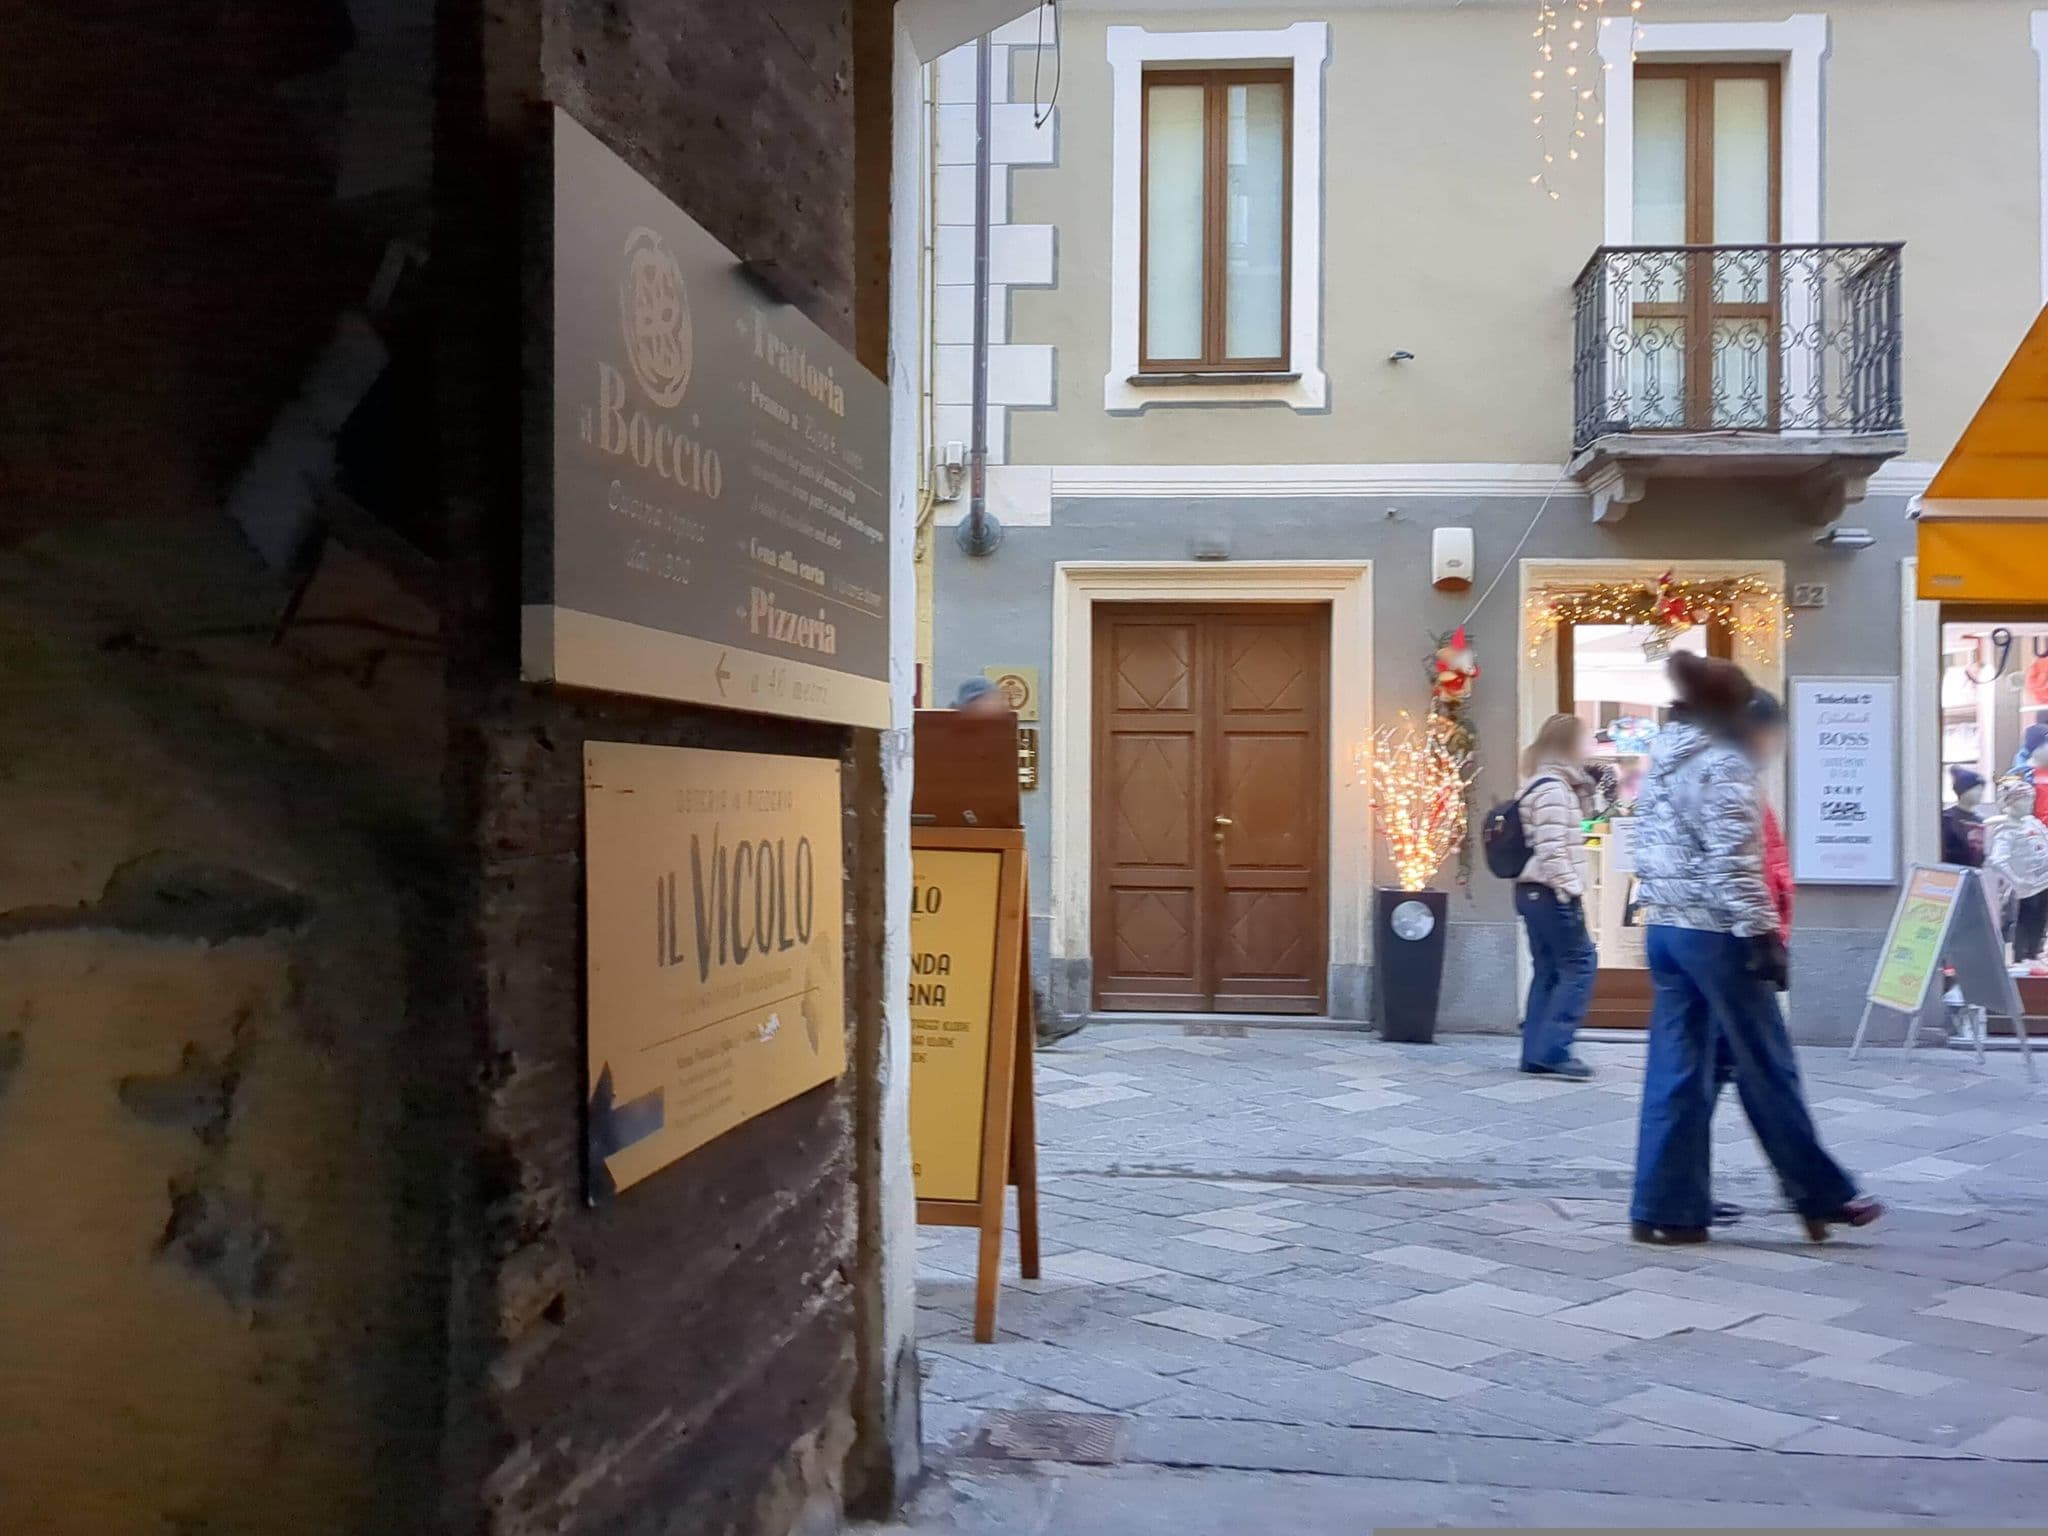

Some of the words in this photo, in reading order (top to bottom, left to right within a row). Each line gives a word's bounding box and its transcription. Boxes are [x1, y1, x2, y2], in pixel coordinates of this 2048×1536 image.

[752, 308, 845, 417] Trattoria
[598, 363, 722, 499] Boccio
[750, 585, 837, 656] Pizzeria
[1818, 732, 1869, 746] BOSS
[656, 869, 684, 969] IL
[689, 821, 814, 983] VICOLO
[912, 886, 942, 914] LO
[911, 953, 951, 976] NDA
[909, 984, 947, 1007] ANA
